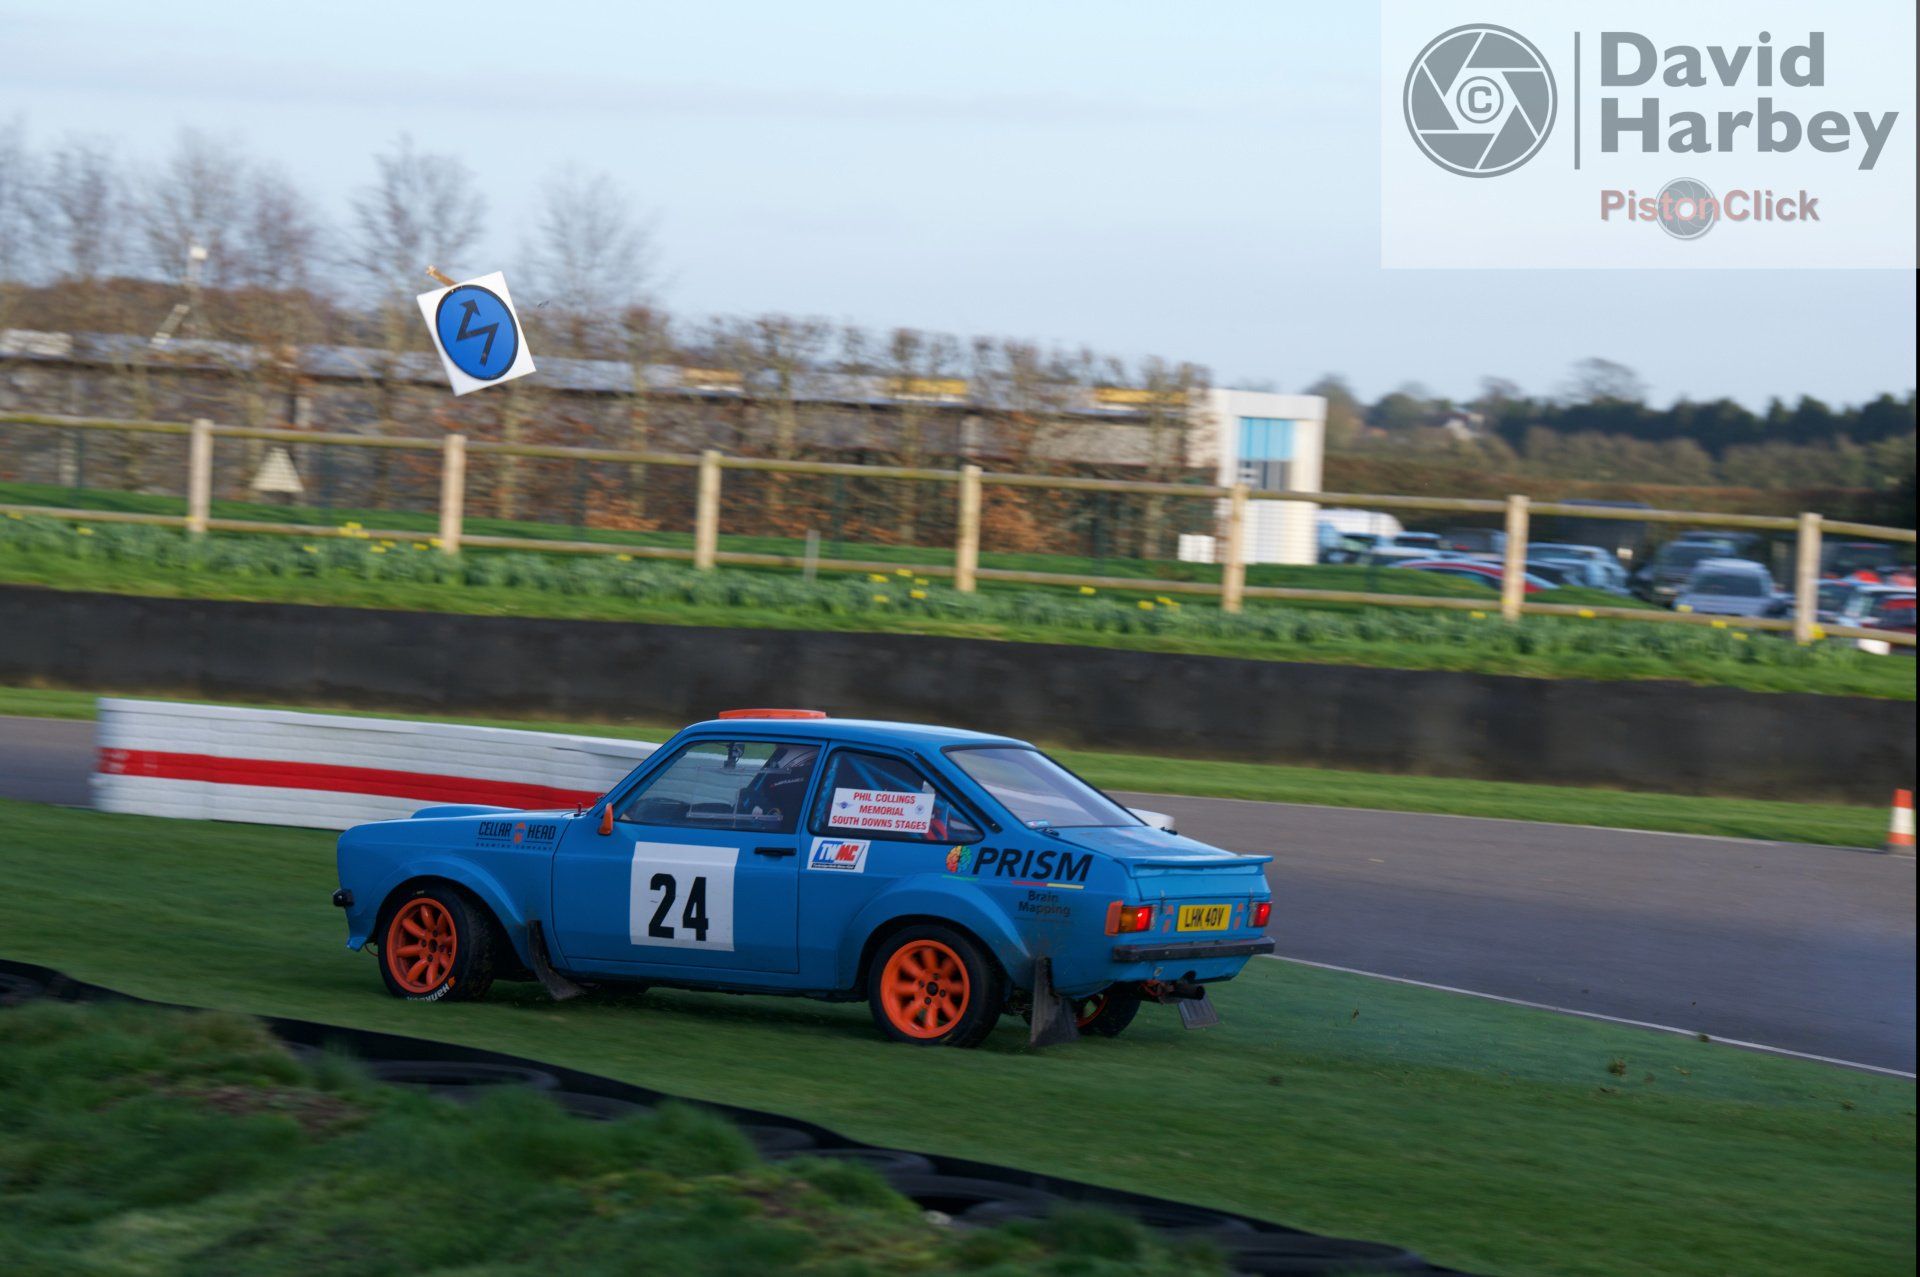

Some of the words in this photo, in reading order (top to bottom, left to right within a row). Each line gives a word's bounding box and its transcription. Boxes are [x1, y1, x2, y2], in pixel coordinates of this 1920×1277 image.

[853, 791, 872, 802] PHIL
[875, 793, 916, 804] COLLINGS
[859, 805, 904, 816] MEMORIAL
[831, 815, 859, 826] SOUTH
[861, 819, 892, 828] DOWNS
[895, 821, 927, 830] STAGES
[479, 821, 512, 838] CELLAR
[527, 824, 557, 841] HEAD
[819, 843, 859, 862] TWMC
[972, 847, 1093, 882] PRISM
[1028, 890, 1059, 902] Brain
[649, 873, 709, 941] 24
[1018, 901, 1071, 917] Mapping
